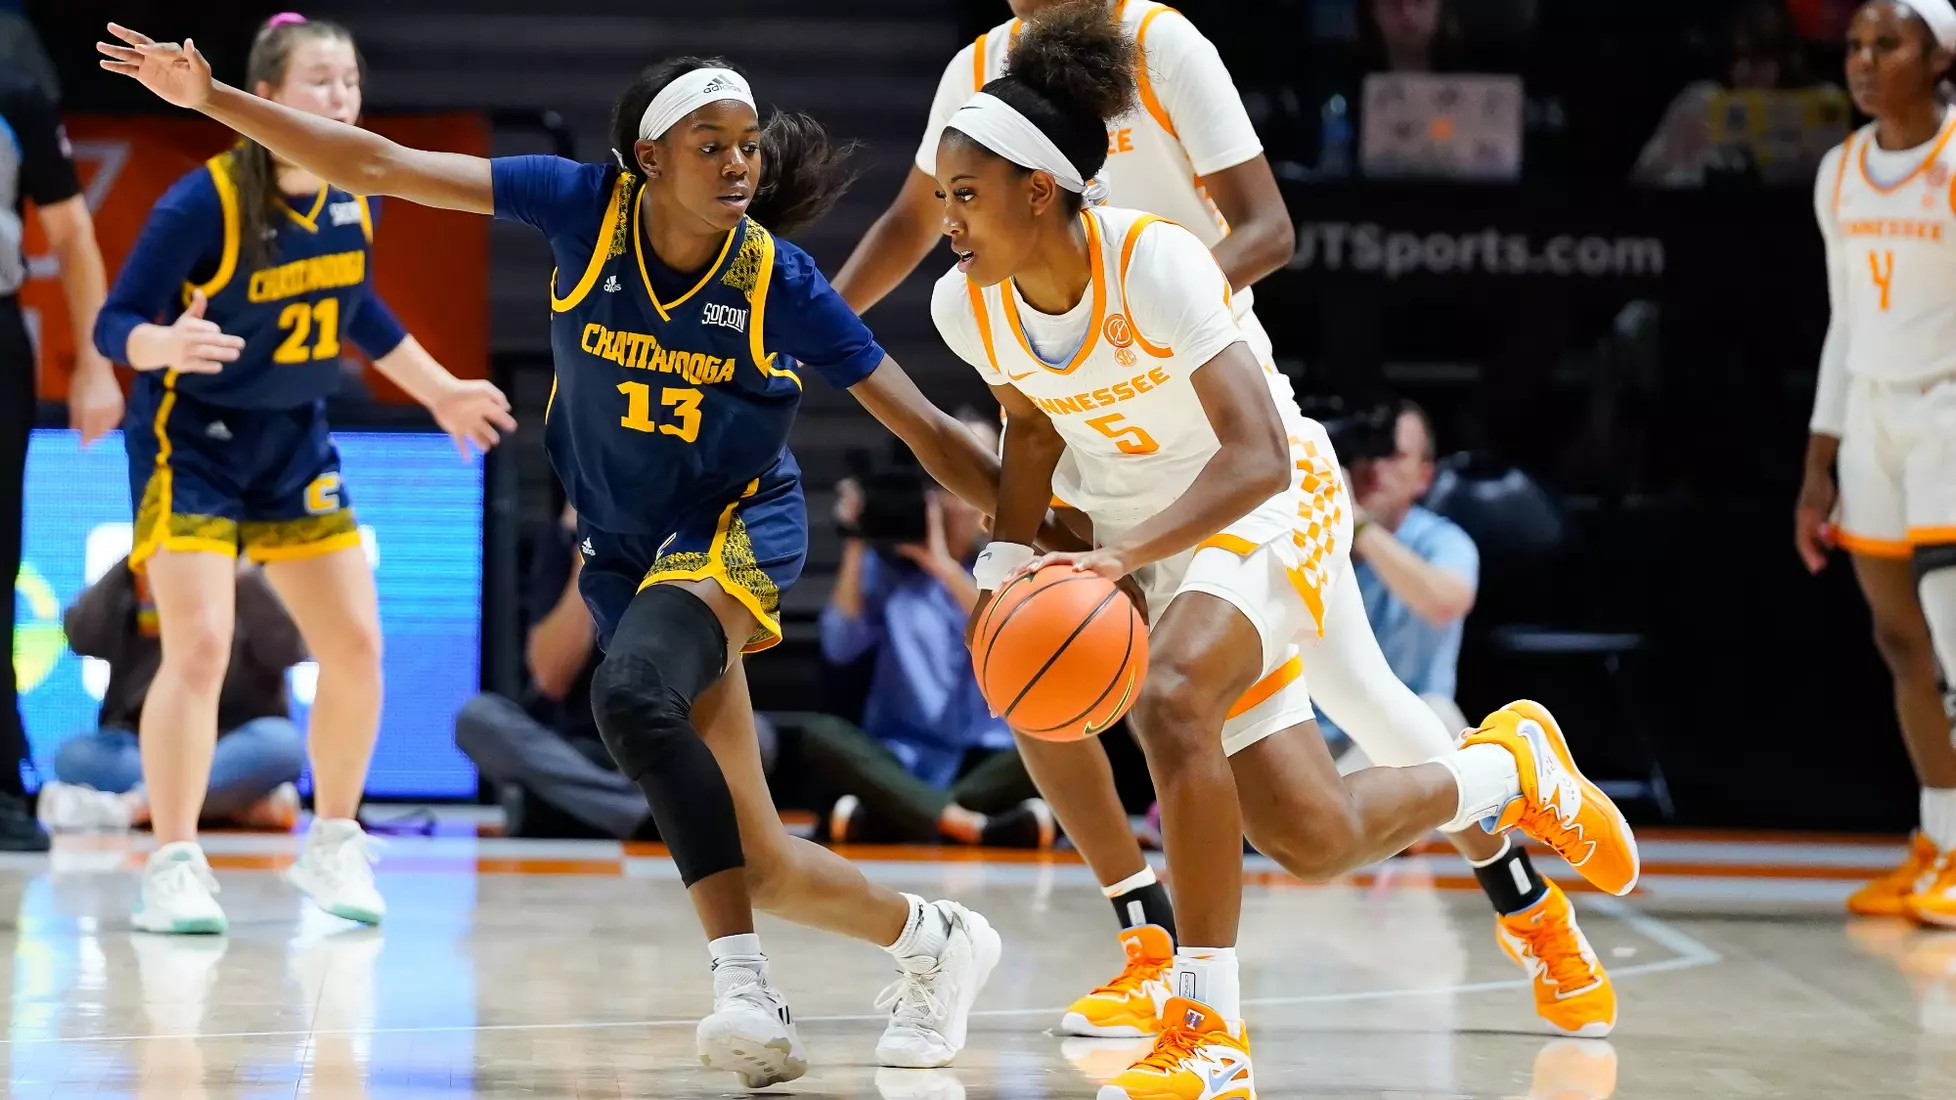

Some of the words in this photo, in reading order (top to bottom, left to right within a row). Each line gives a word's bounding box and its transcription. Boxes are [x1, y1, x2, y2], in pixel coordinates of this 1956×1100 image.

[1868, 249, 1894, 313] 4
[273, 297, 341, 364] 21
[701, 302, 748, 333] SOCON
[616, 381, 704, 443] 13
[1084, 412, 1160, 454] 5
[303, 471, 341, 516] C
